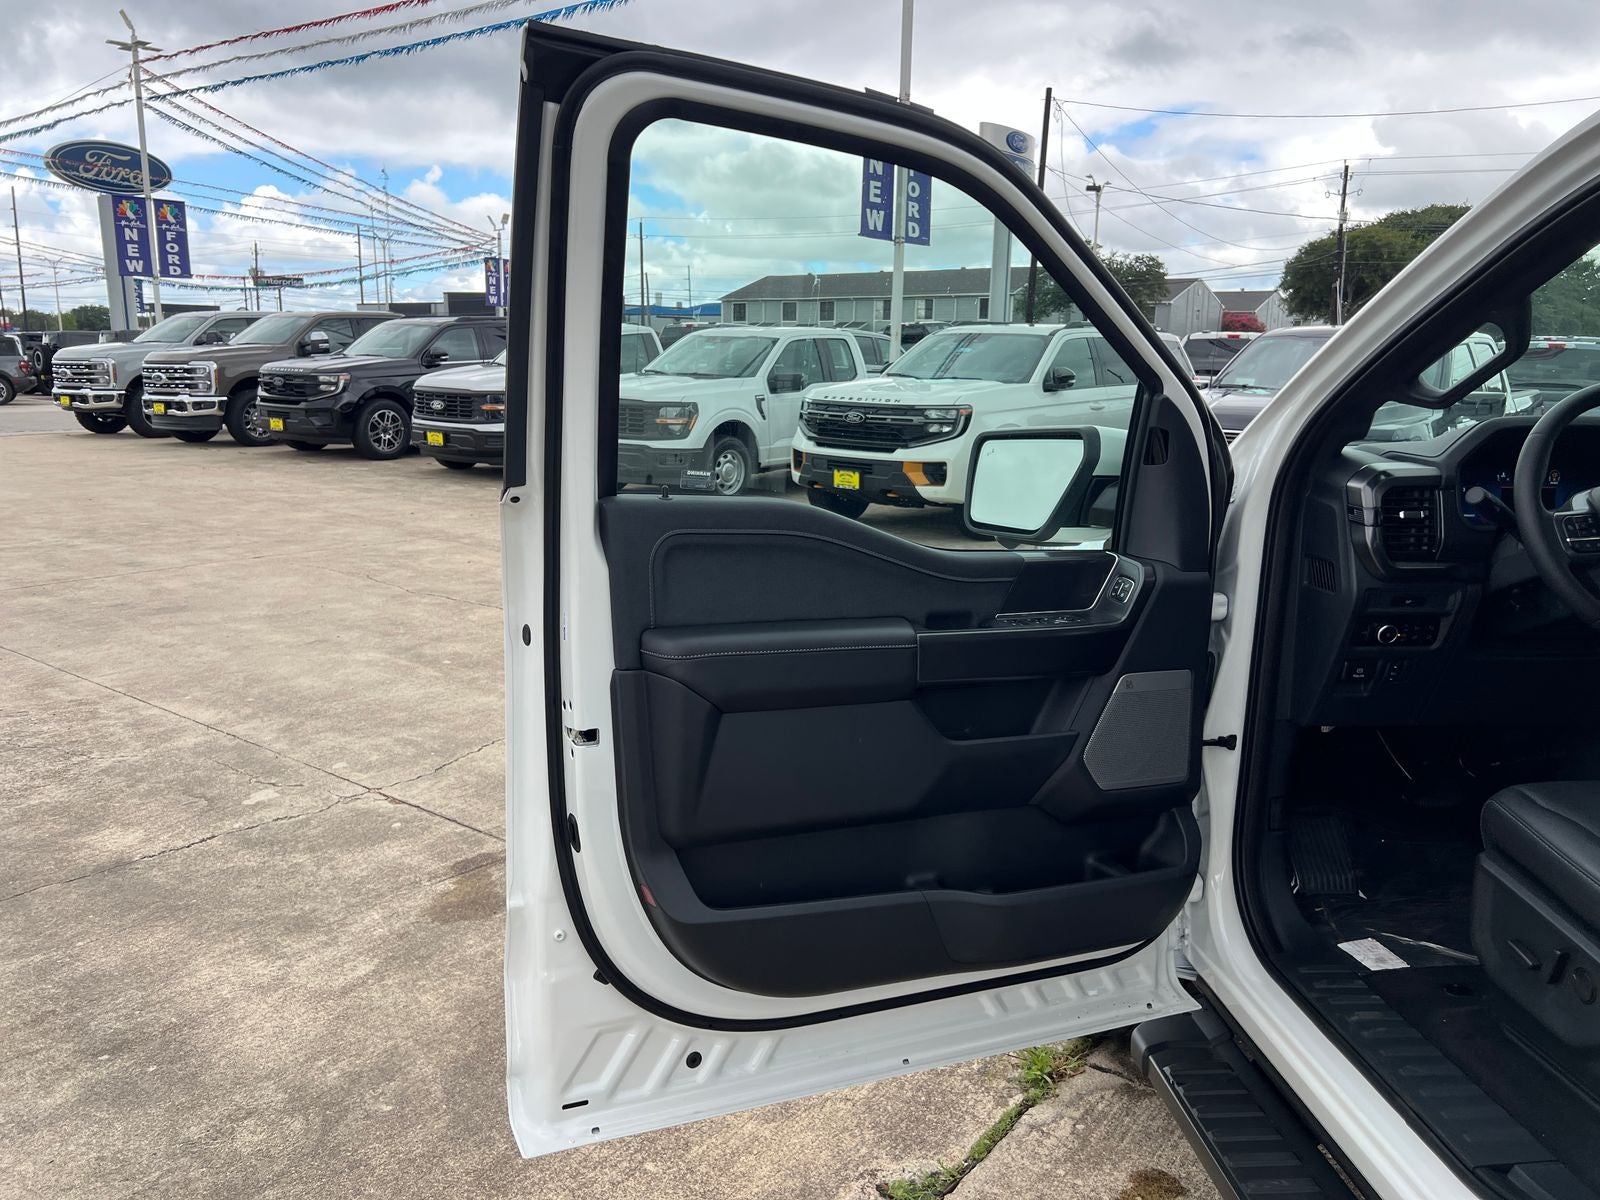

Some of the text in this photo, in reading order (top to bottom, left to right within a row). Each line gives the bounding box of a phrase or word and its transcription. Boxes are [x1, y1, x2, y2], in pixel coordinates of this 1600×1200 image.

[866, 158, 885, 232] NEW
[124, 227, 144, 273] NEW
[165, 231, 182, 275] FORD
[488, 276, 498, 304] NEW
[823, 395, 901, 403] EXPEDITION
